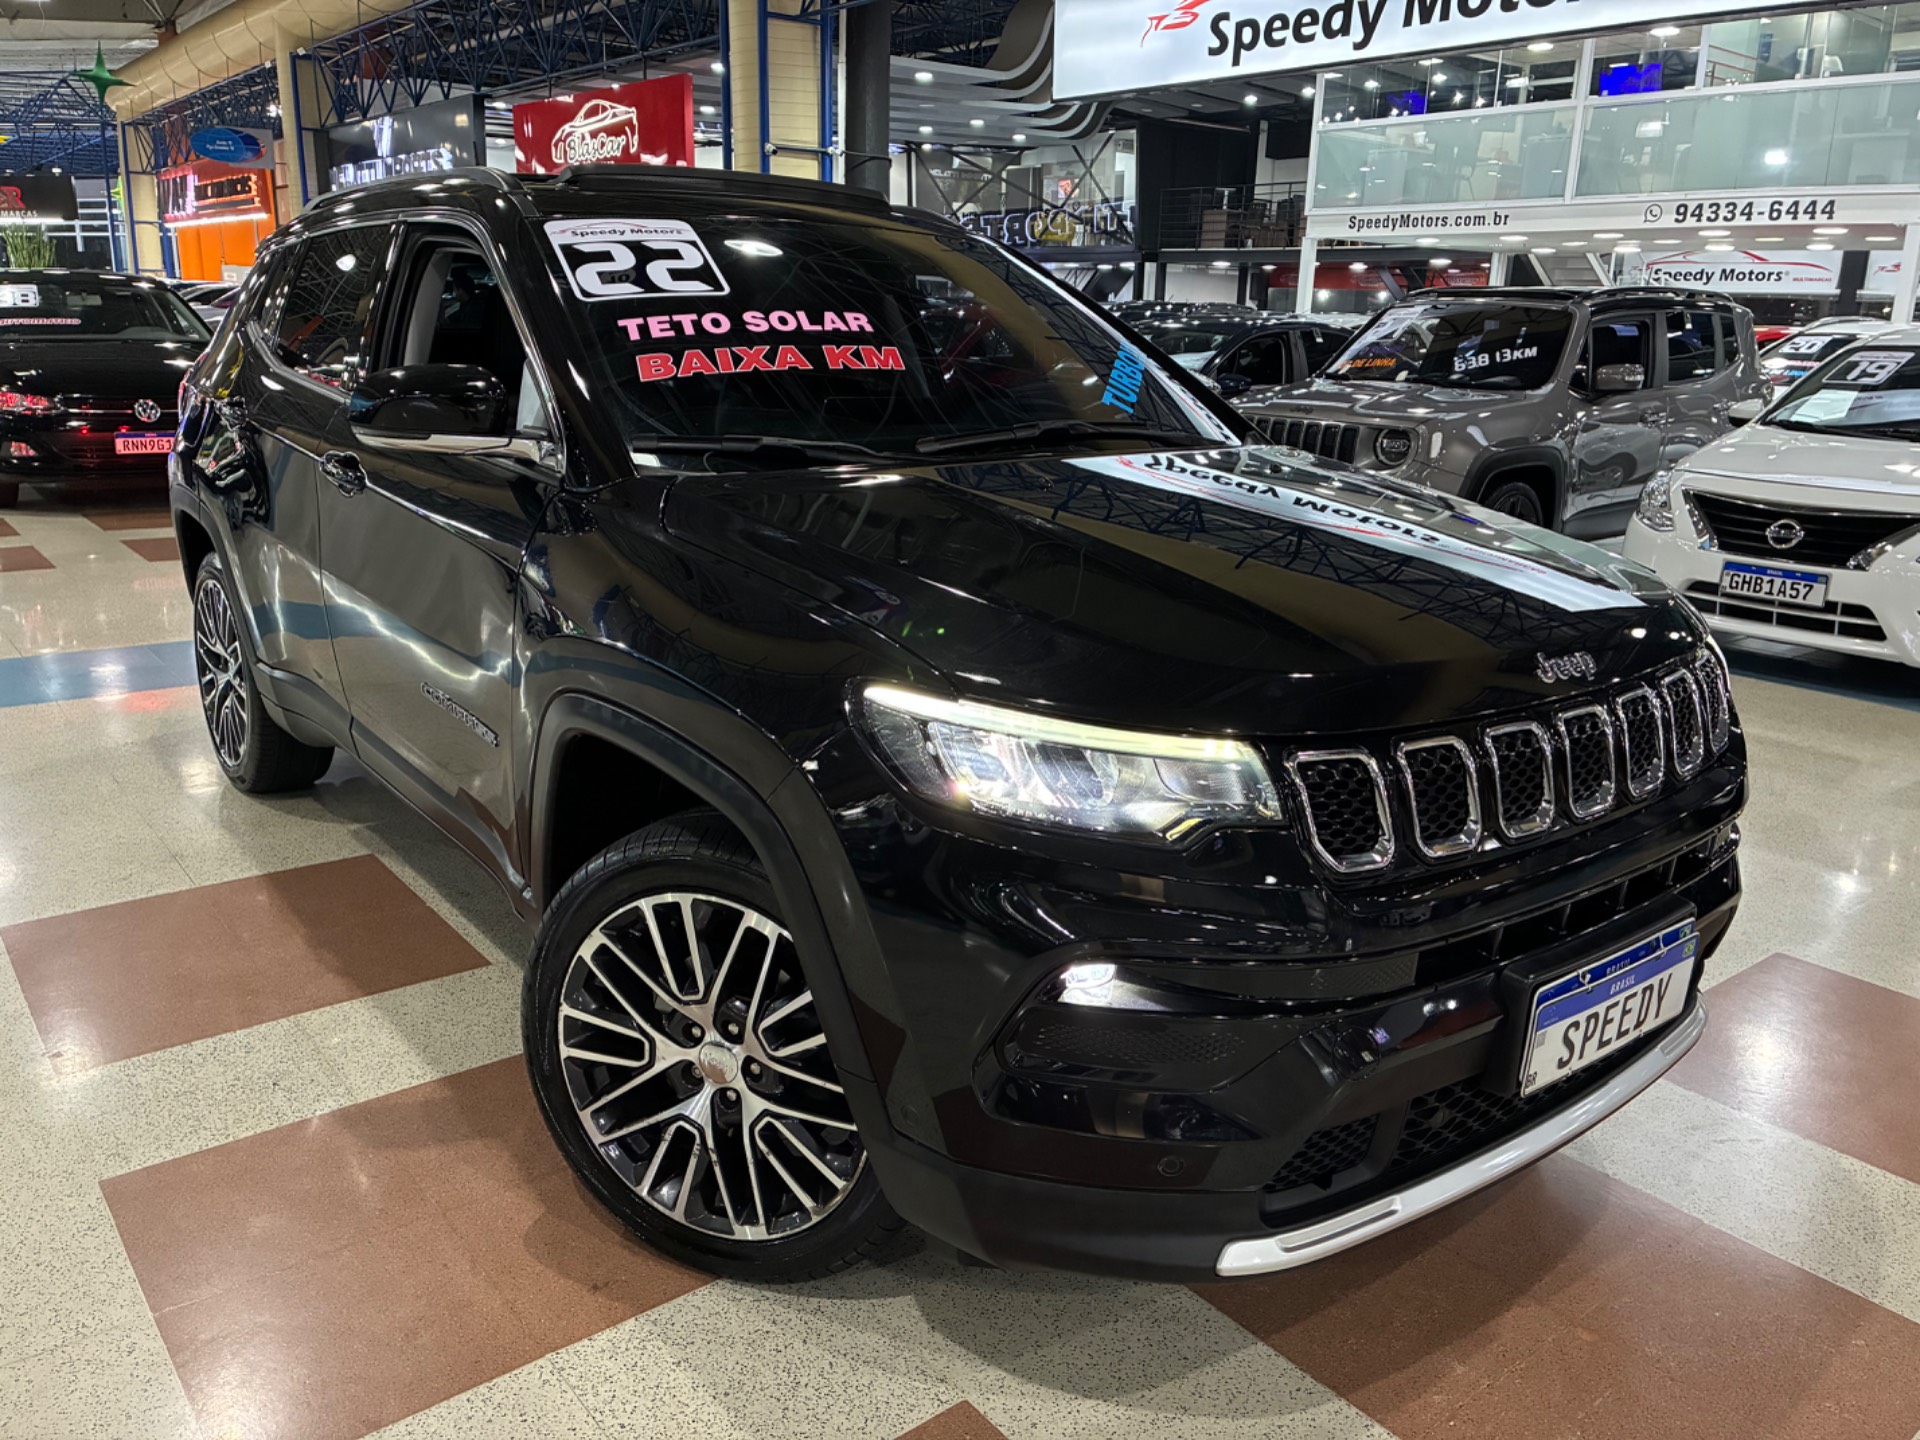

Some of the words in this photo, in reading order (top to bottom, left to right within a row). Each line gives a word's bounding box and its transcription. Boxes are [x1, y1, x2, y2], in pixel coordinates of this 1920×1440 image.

[1207, 0, 1388, 66] Speedy
[1348, 211, 1510, 232] SpeedyMotors.com.br
[1674, 199, 1836, 223] 94334-6444
[571, 228, 626, 238] Speedy
[630, 228, 684, 236] Motors
[571, 240, 715, 295] 22
[1719, 268, 1784, 283] Motors
[617, 312, 732, 341] TETO
[742, 310, 875, 333] SOLAR
[636, 345, 814, 383] BAIXA
[822, 345, 906, 371] KM
[1846, 360, 1898, 381] 19
[1728, 573, 1815, 601] GHB1A57
[1537, 651, 1597, 683] Jeep
[1557, 972, 1673, 1070] SPEEDY
